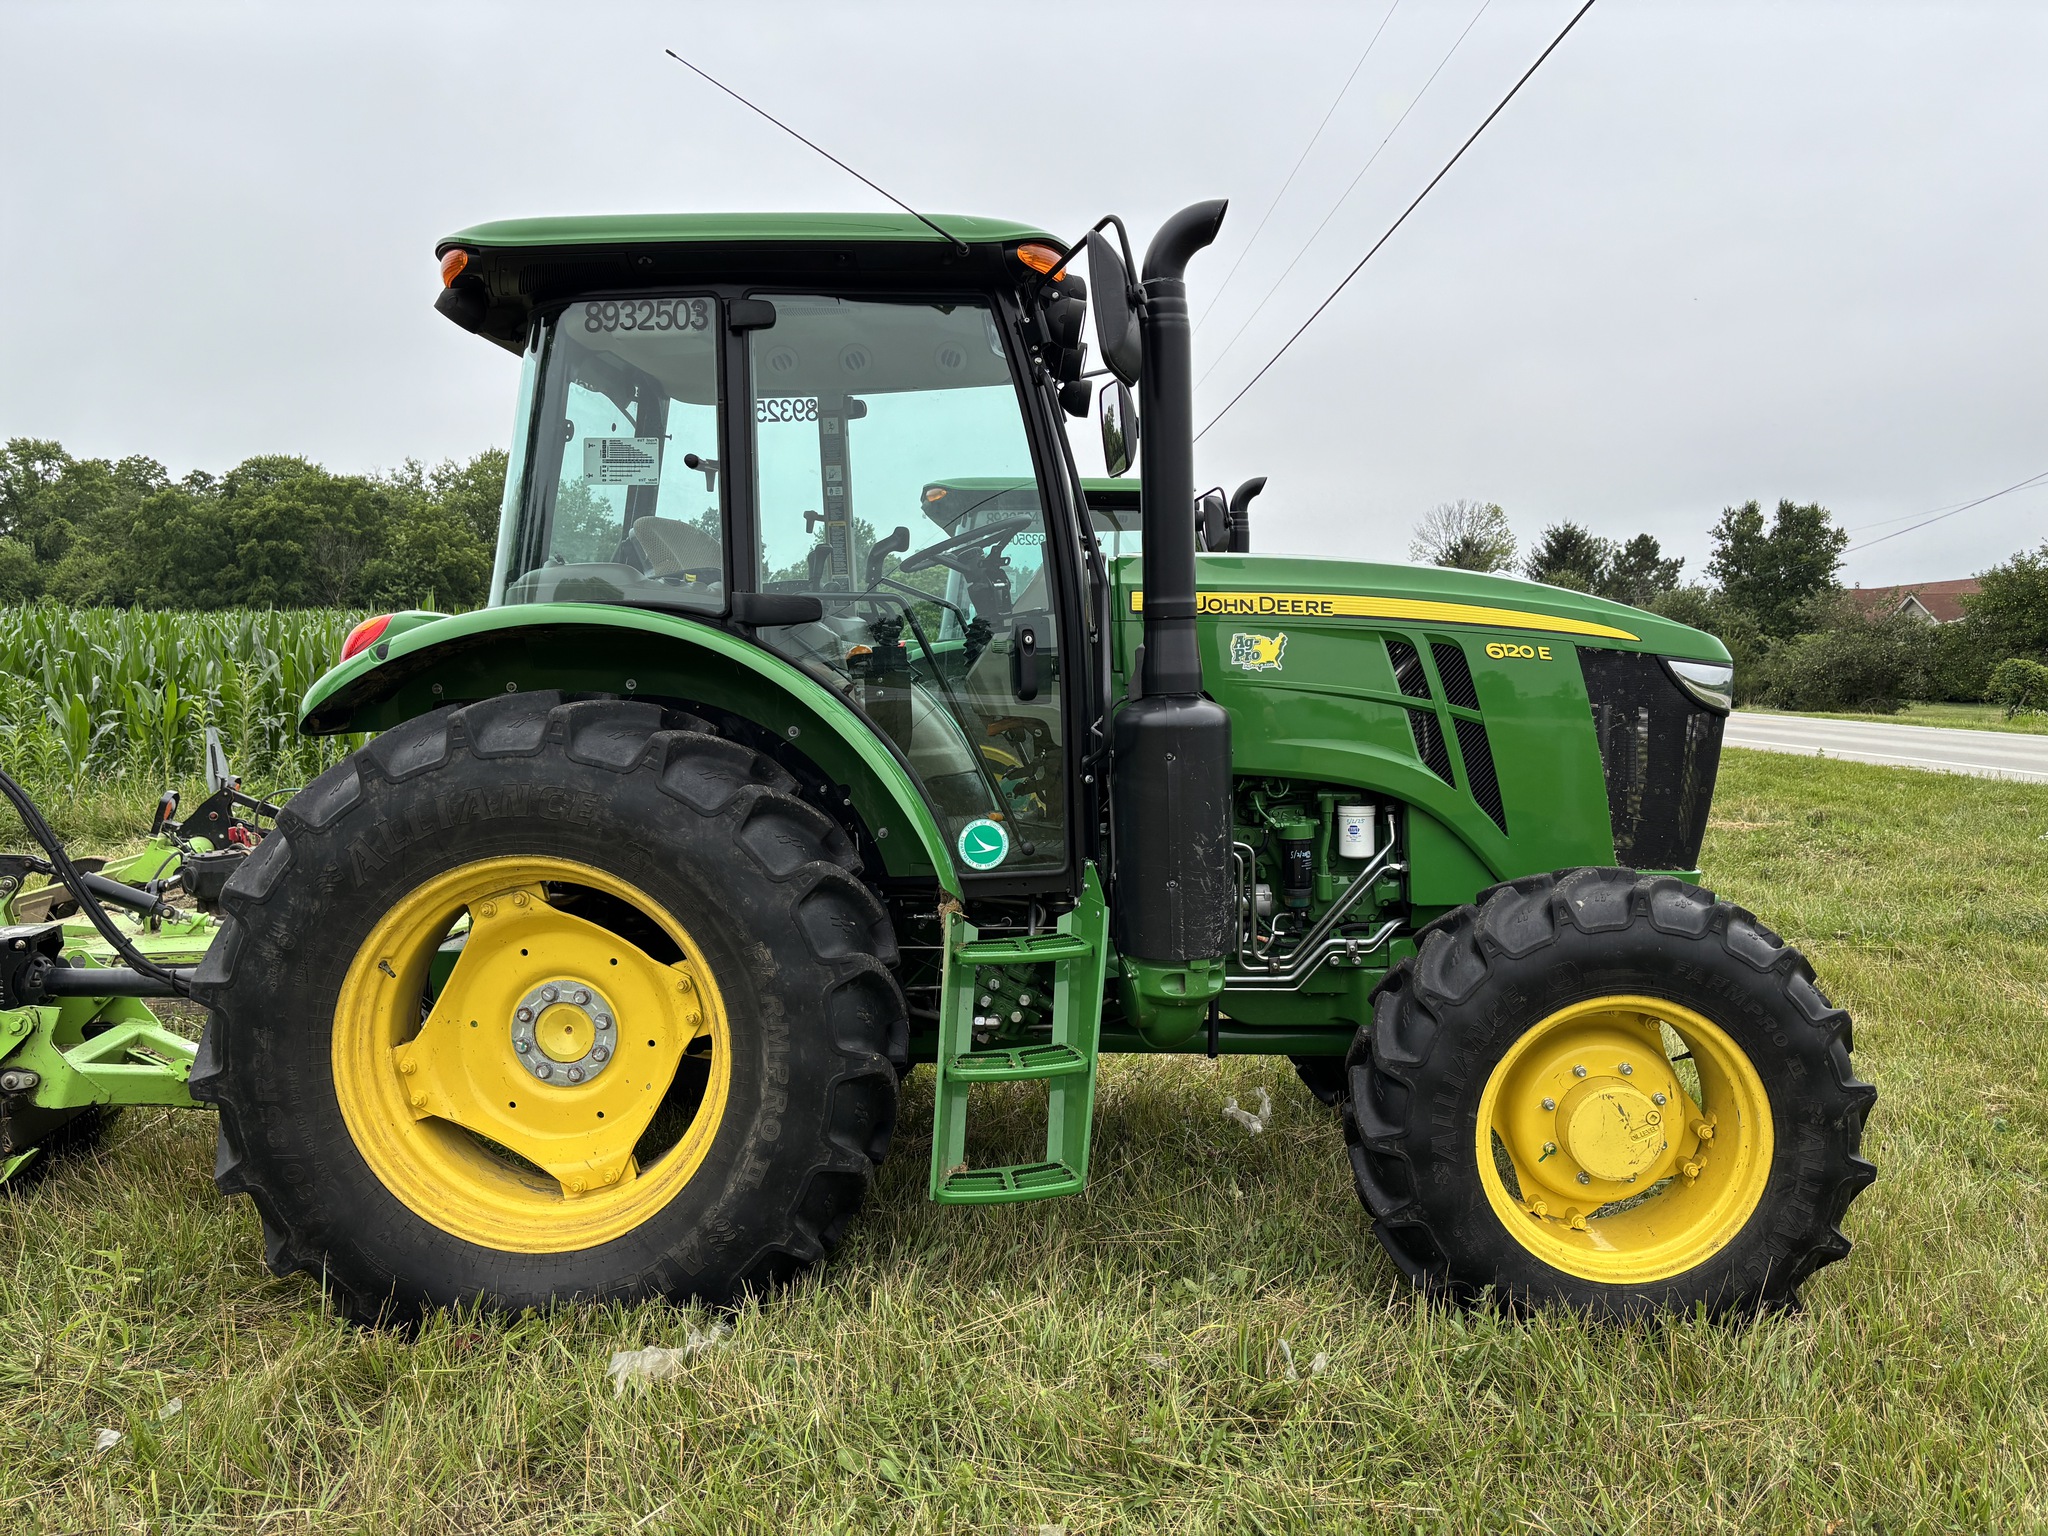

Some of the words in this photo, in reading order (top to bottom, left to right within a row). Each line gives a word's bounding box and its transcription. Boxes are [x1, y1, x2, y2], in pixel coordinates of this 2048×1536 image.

[584, 299, 709, 333] 8932503
[1197, 595, 1254, 612] JOHN
[1259, 596, 1334, 614] DEERE
[1234, 648, 1261, 662] Pro
[1485, 642, 1535, 660] 6120
[1537, 646, 1553, 661] E
[342, 781, 603, 890] ALLIANCE
[1672, 960, 1788, 1048] FARMPRO
[749, 940, 792, 1144] FARMPRO
[1431, 984, 1527, 1163] ALLIANCE
